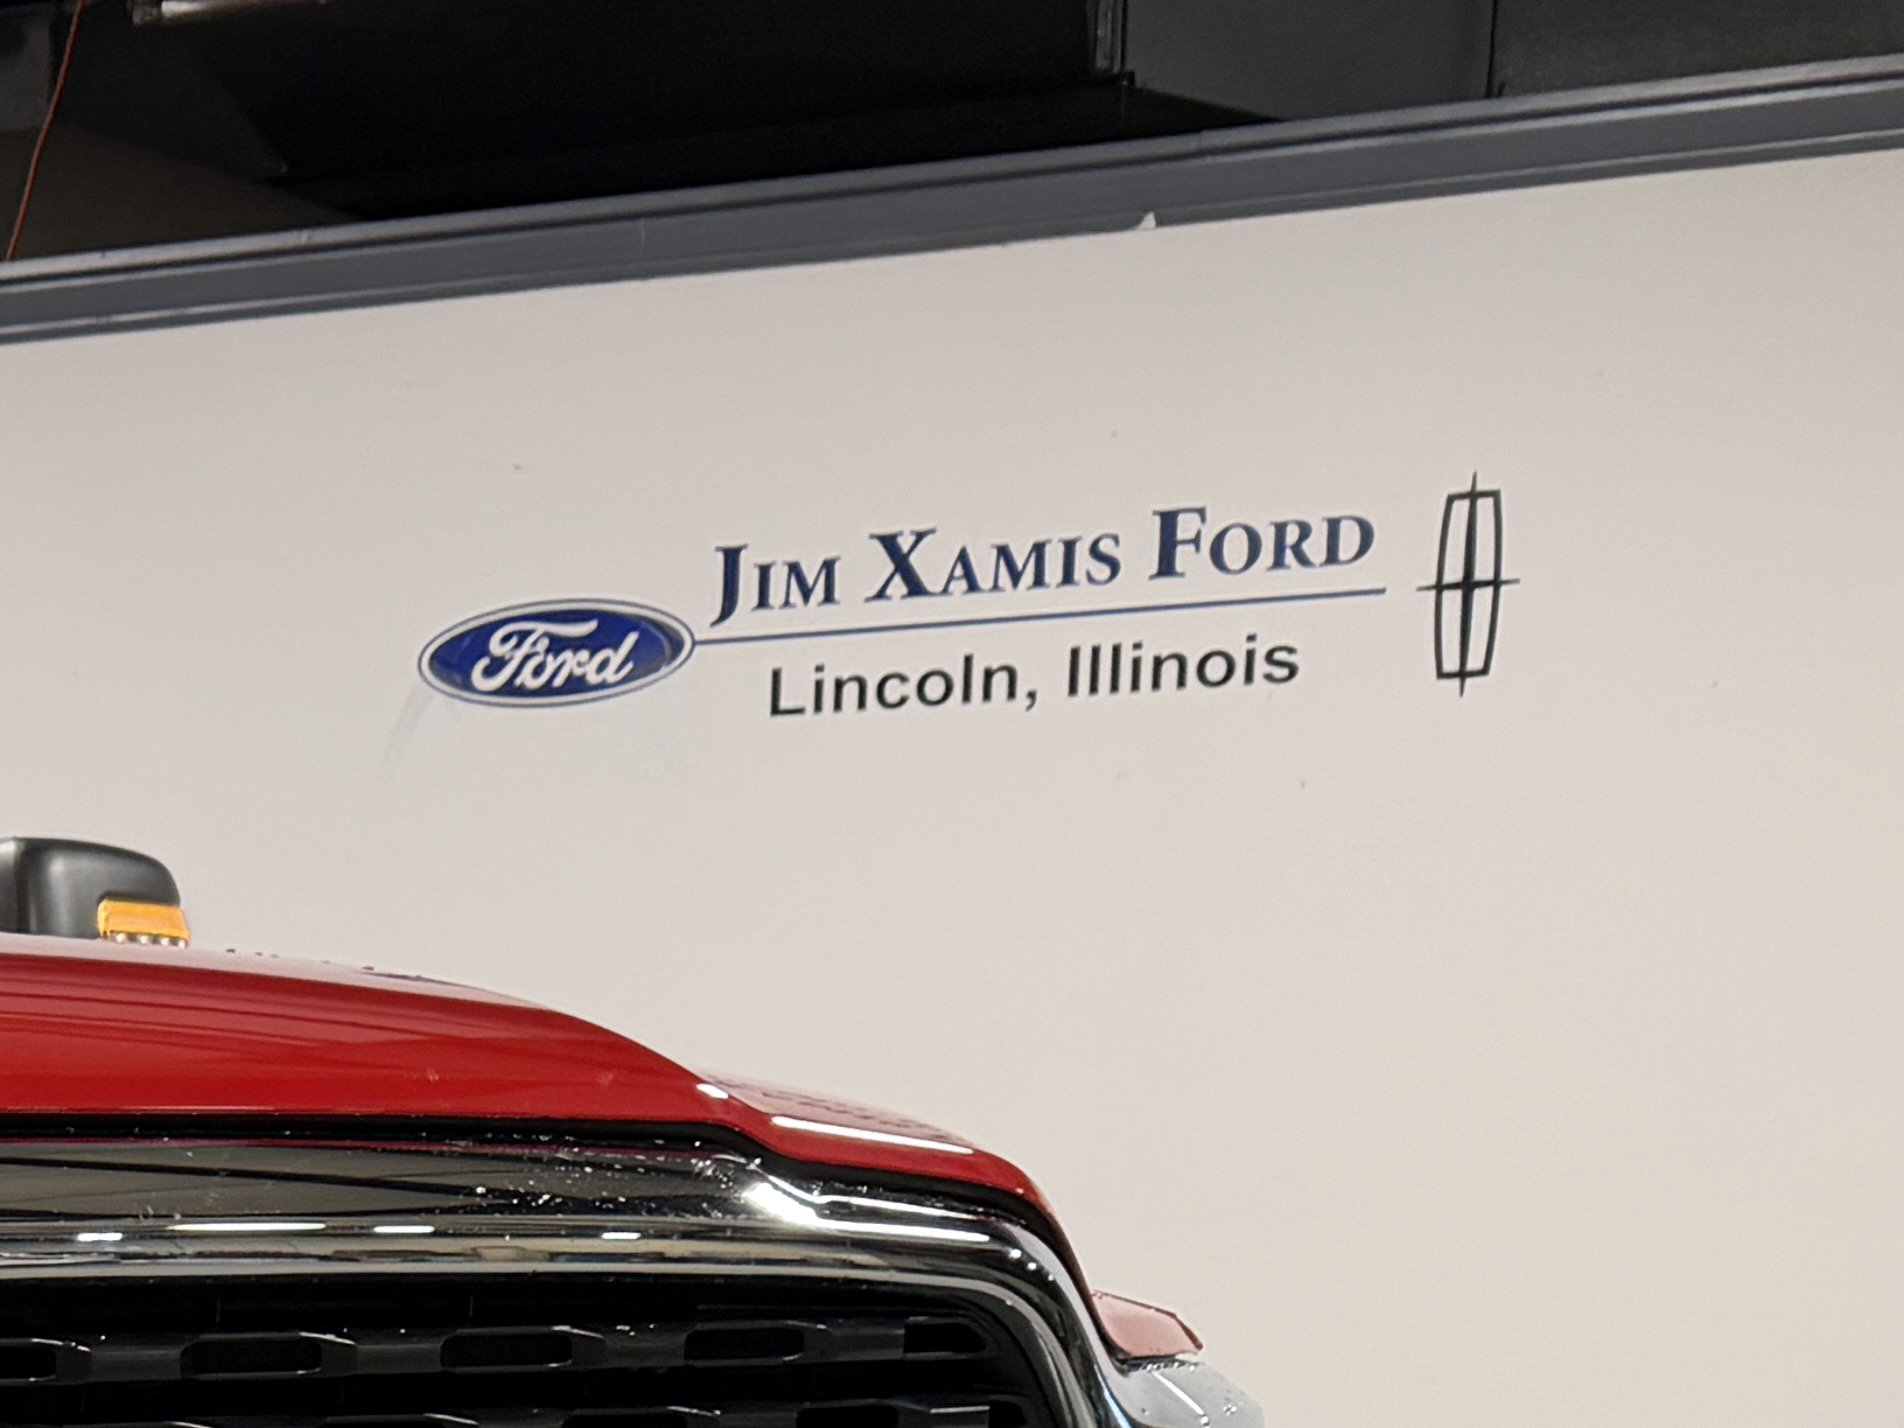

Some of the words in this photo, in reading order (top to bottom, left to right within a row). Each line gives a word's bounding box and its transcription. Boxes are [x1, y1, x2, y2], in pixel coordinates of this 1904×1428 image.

[710, 543, 841, 627] JIM
[864, 527, 1122, 602] XAMIS
[1148, 506, 1376, 581] FORD
[470, 618, 640, 692] Ford
[769, 653, 1038, 717] Lincoln,
[1067, 632, 1300, 698] Illinois
